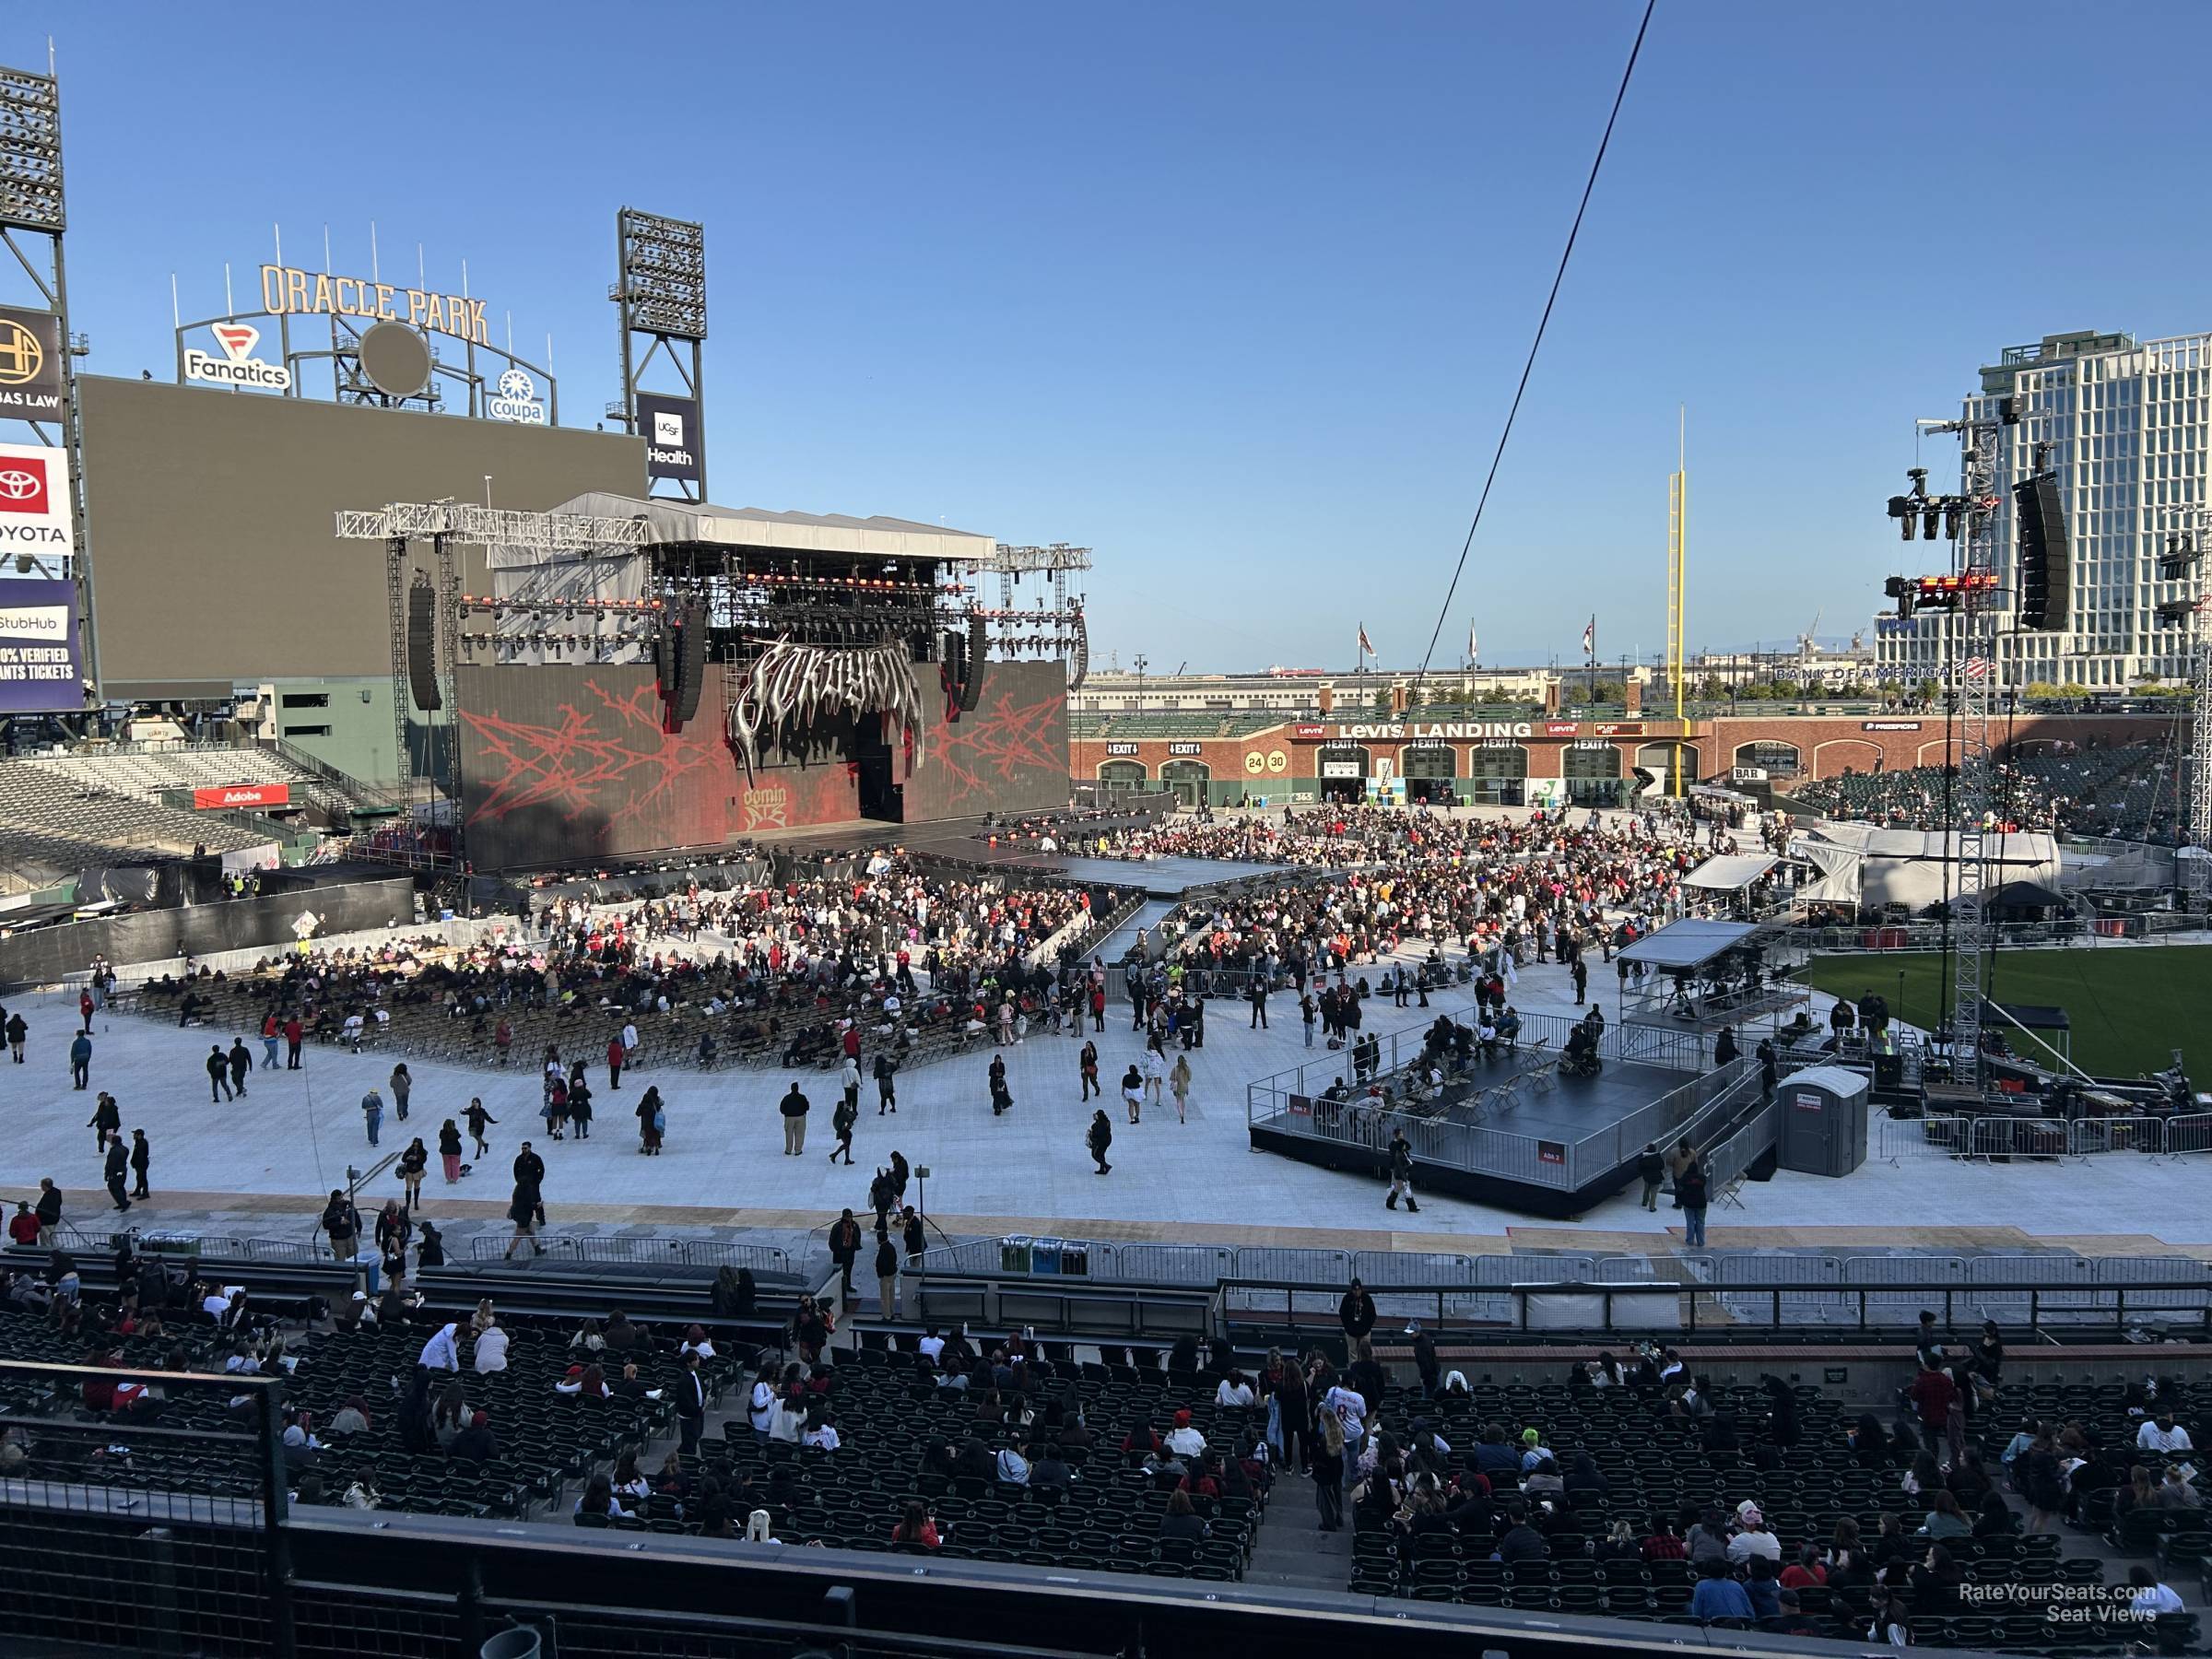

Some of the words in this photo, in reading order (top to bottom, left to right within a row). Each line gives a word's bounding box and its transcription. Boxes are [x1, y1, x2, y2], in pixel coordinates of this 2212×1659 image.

[262, 265, 395, 321] ORACLE
[406, 289, 490, 347] PARK
[190, 354, 286, 385] Fanatics
[26, 394, 59, 408] LAW
[494, 402, 540, 421] coupa
[659, 422, 678, 436] UCSF
[648, 447, 692, 465] Health
[0, 525, 66, 543] YOTA
[19, 647, 69, 663] VERIFIED
[27, 665, 74, 680] TICKETS
[1776, 668, 1827, 680] BANK
[1831, 668, 1856, 679] OF
[1862, 666, 1949, 679] AMERICA
[1414, 723, 1533, 737] LANDING
[1112, 744, 1133, 754] EXIT
[1175, 744, 1195, 754] EXIT
[1331, 739, 1352, 749] EXIT
[1418, 738, 1440, 748] EXIT
[1488, 738, 1511, 748] EXIT
[1580, 739, 1604, 749] EXIT
[1249, 758, 1262, 768] 24
[1271, 757, 1283, 766] 30
[1735, 769, 1758, 778] BAR
[224, 792, 262, 803] Adobe
